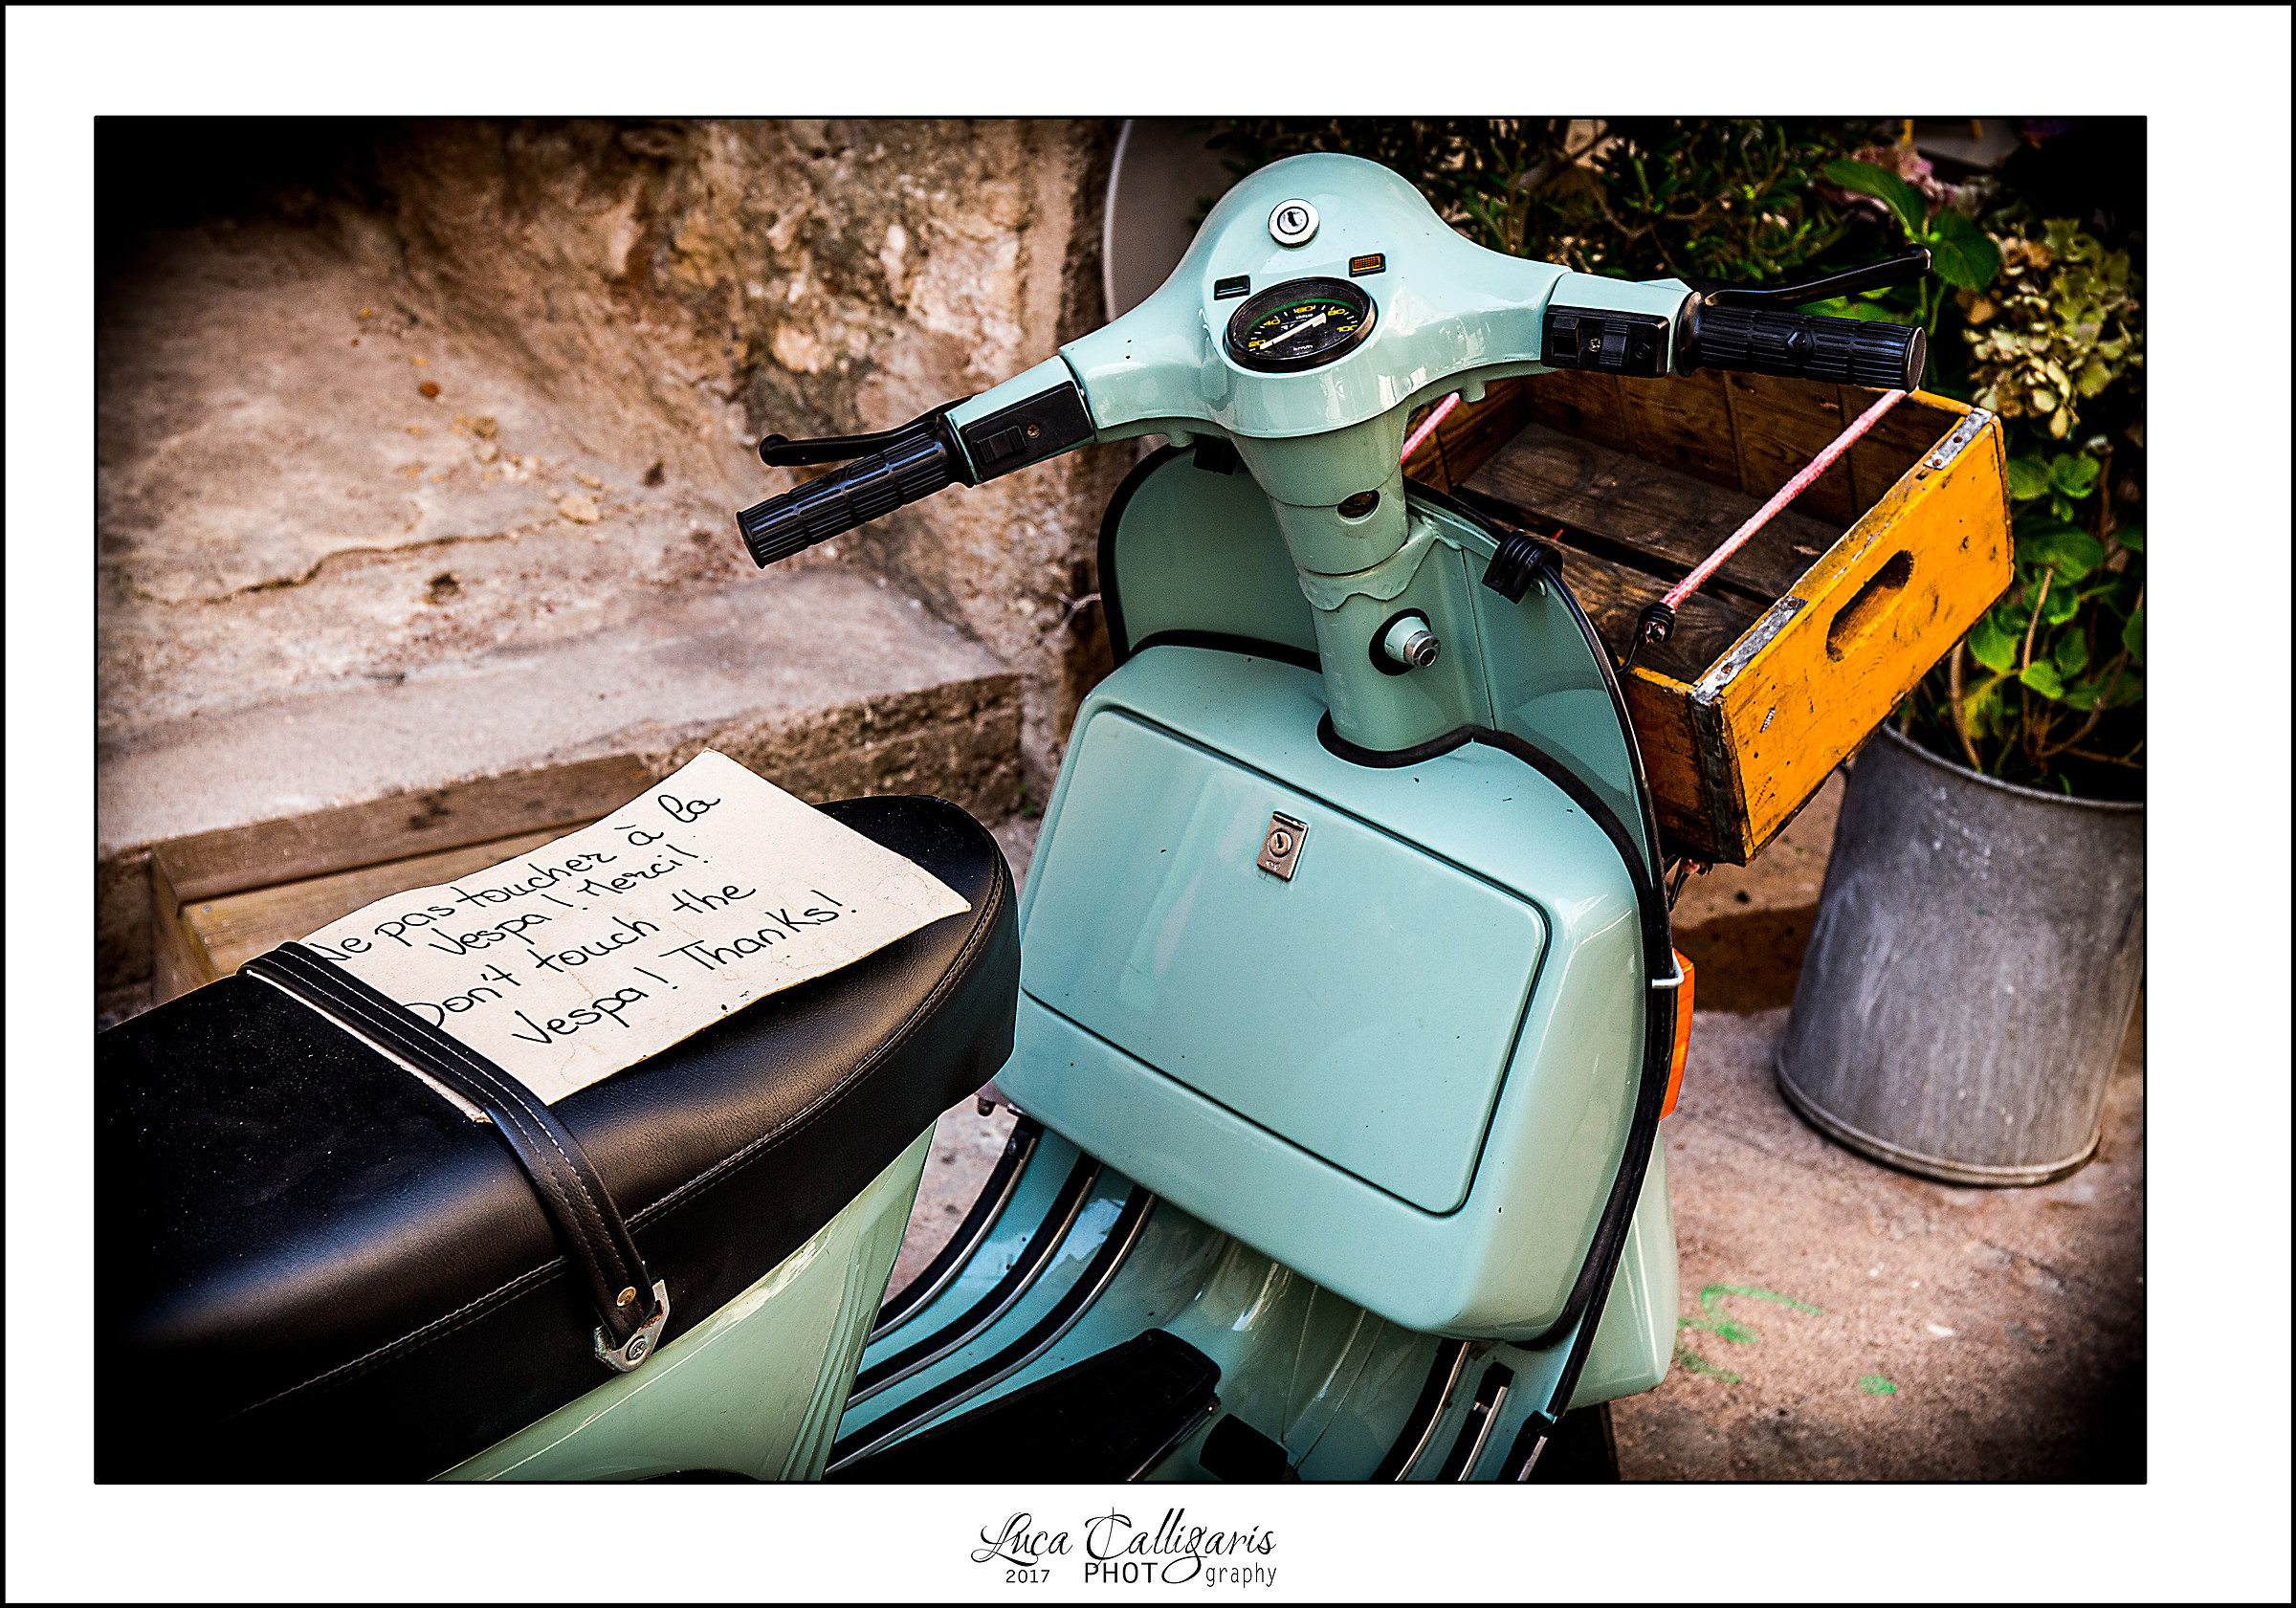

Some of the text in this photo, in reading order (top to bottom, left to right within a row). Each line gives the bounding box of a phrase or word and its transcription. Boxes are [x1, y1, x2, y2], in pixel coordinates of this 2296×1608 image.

[374, 905, 455, 947] pas
[454, 852, 618, 908] toucher
[613, 824, 665, 847] à
[657, 794, 721, 824] la
[576, 843, 710, 897] Merci!
[526, 915, 660, 973] touch
[671, 884, 757, 914] the
[657, 889, 857, 971] Thanks!
